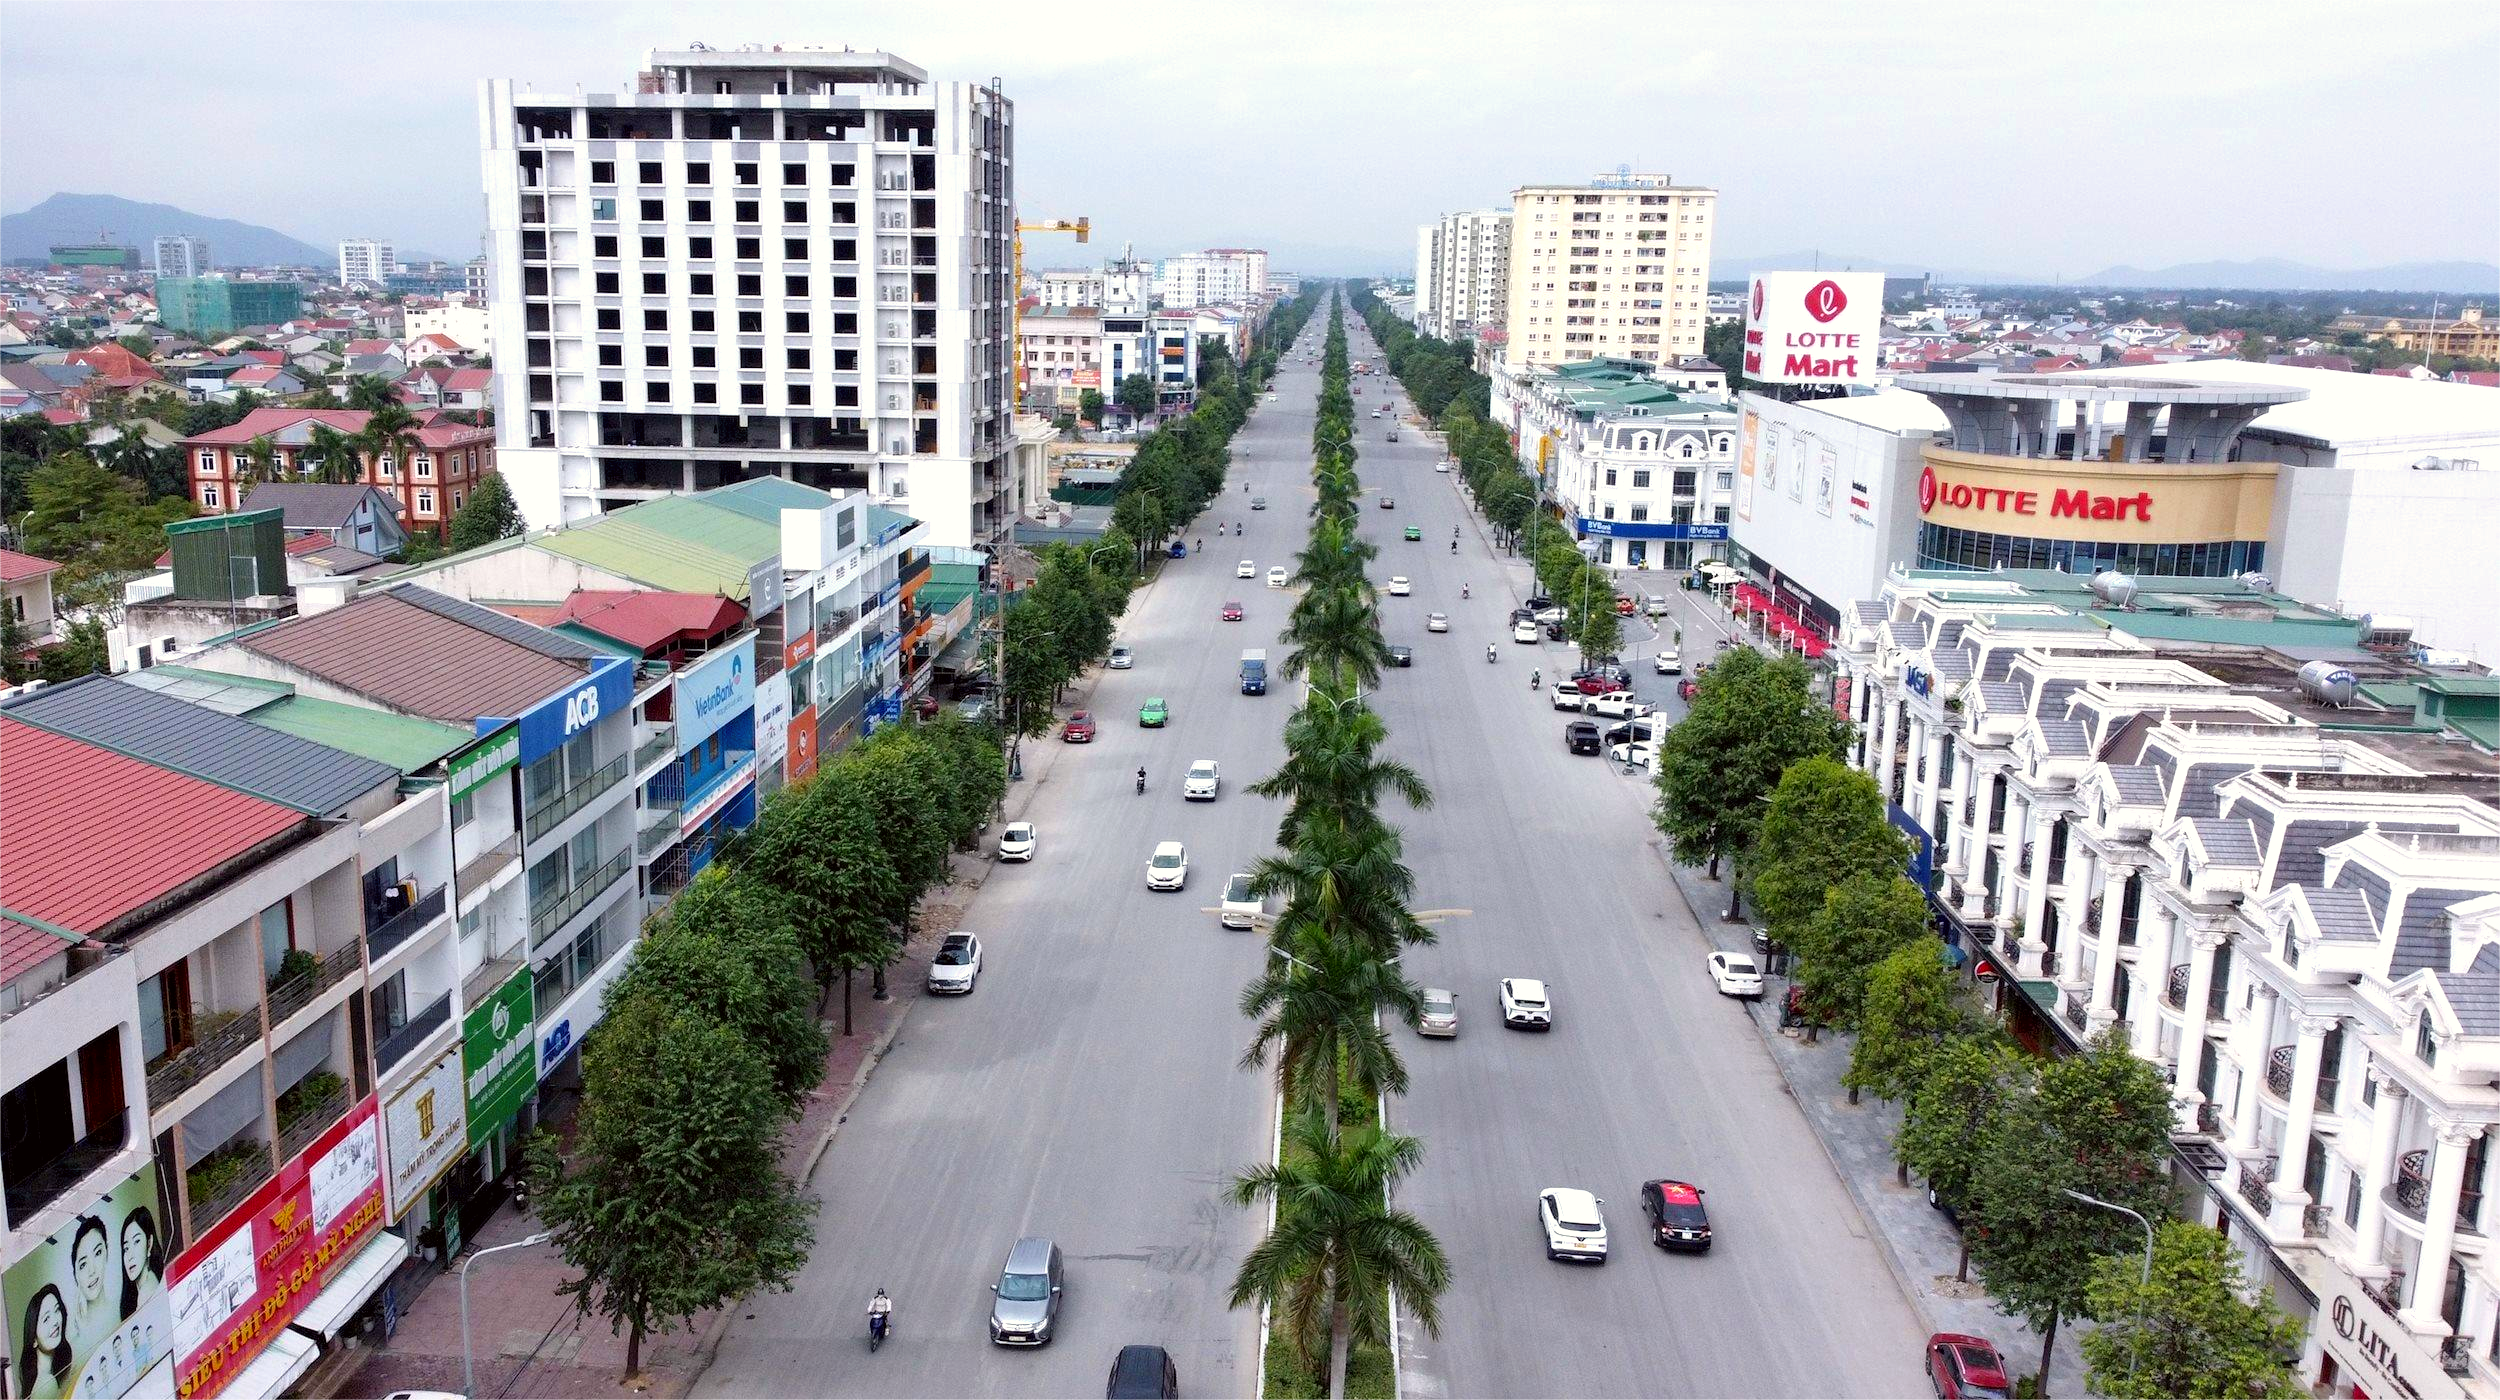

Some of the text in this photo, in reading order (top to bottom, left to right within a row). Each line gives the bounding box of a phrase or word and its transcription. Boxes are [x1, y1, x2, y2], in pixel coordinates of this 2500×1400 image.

[1785, 332, 1861, 348] LOTTE
[1783, 353, 1858, 377] Mart
[1940, 481, 2154, 522] LOTTE Mart
[1689, 525, 1721, 534] BVBank
[565, 685, 599, 736] ACB
[541, 1019, 571, 1072] ACB
[2357, 1318, 2399, 1379] LITA
